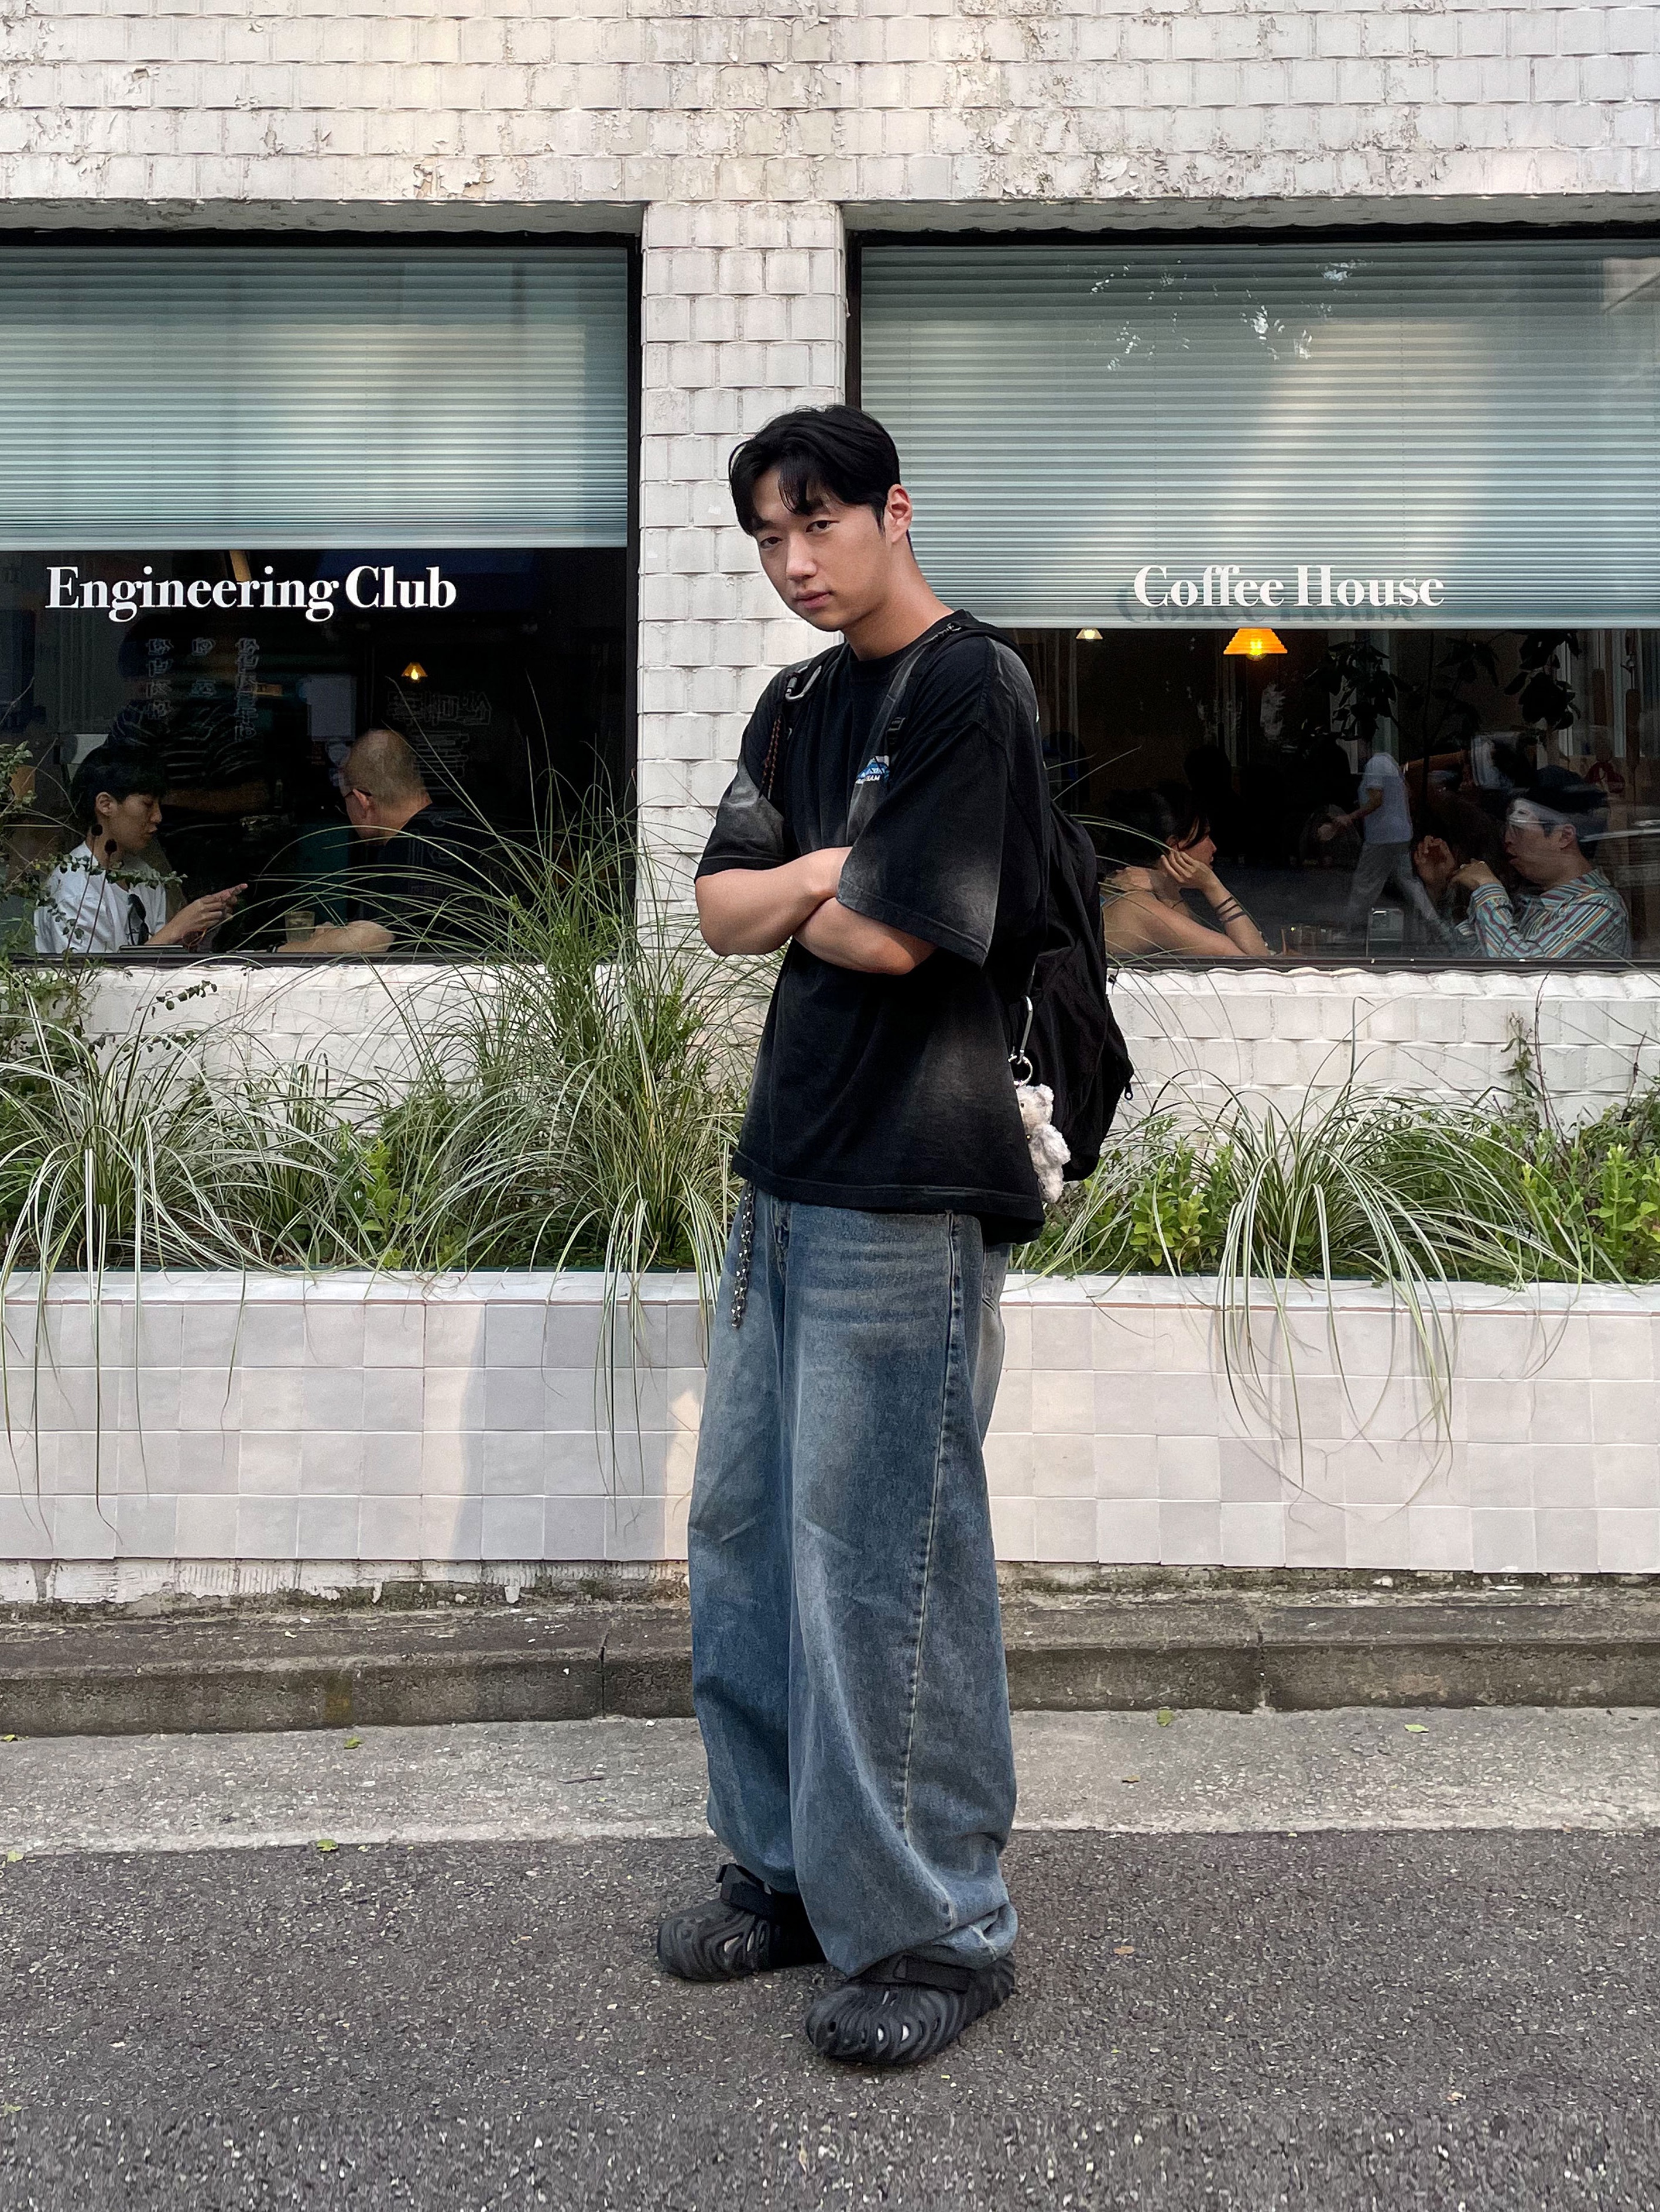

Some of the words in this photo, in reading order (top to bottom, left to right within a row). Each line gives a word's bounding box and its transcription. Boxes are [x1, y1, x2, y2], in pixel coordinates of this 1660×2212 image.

[45, 565, 339, 622] Engineering
[345, 565, 457, 608] Club
[1133, 564, 1285, 607] Coffee
[1292, 564, 1445, 607] House
